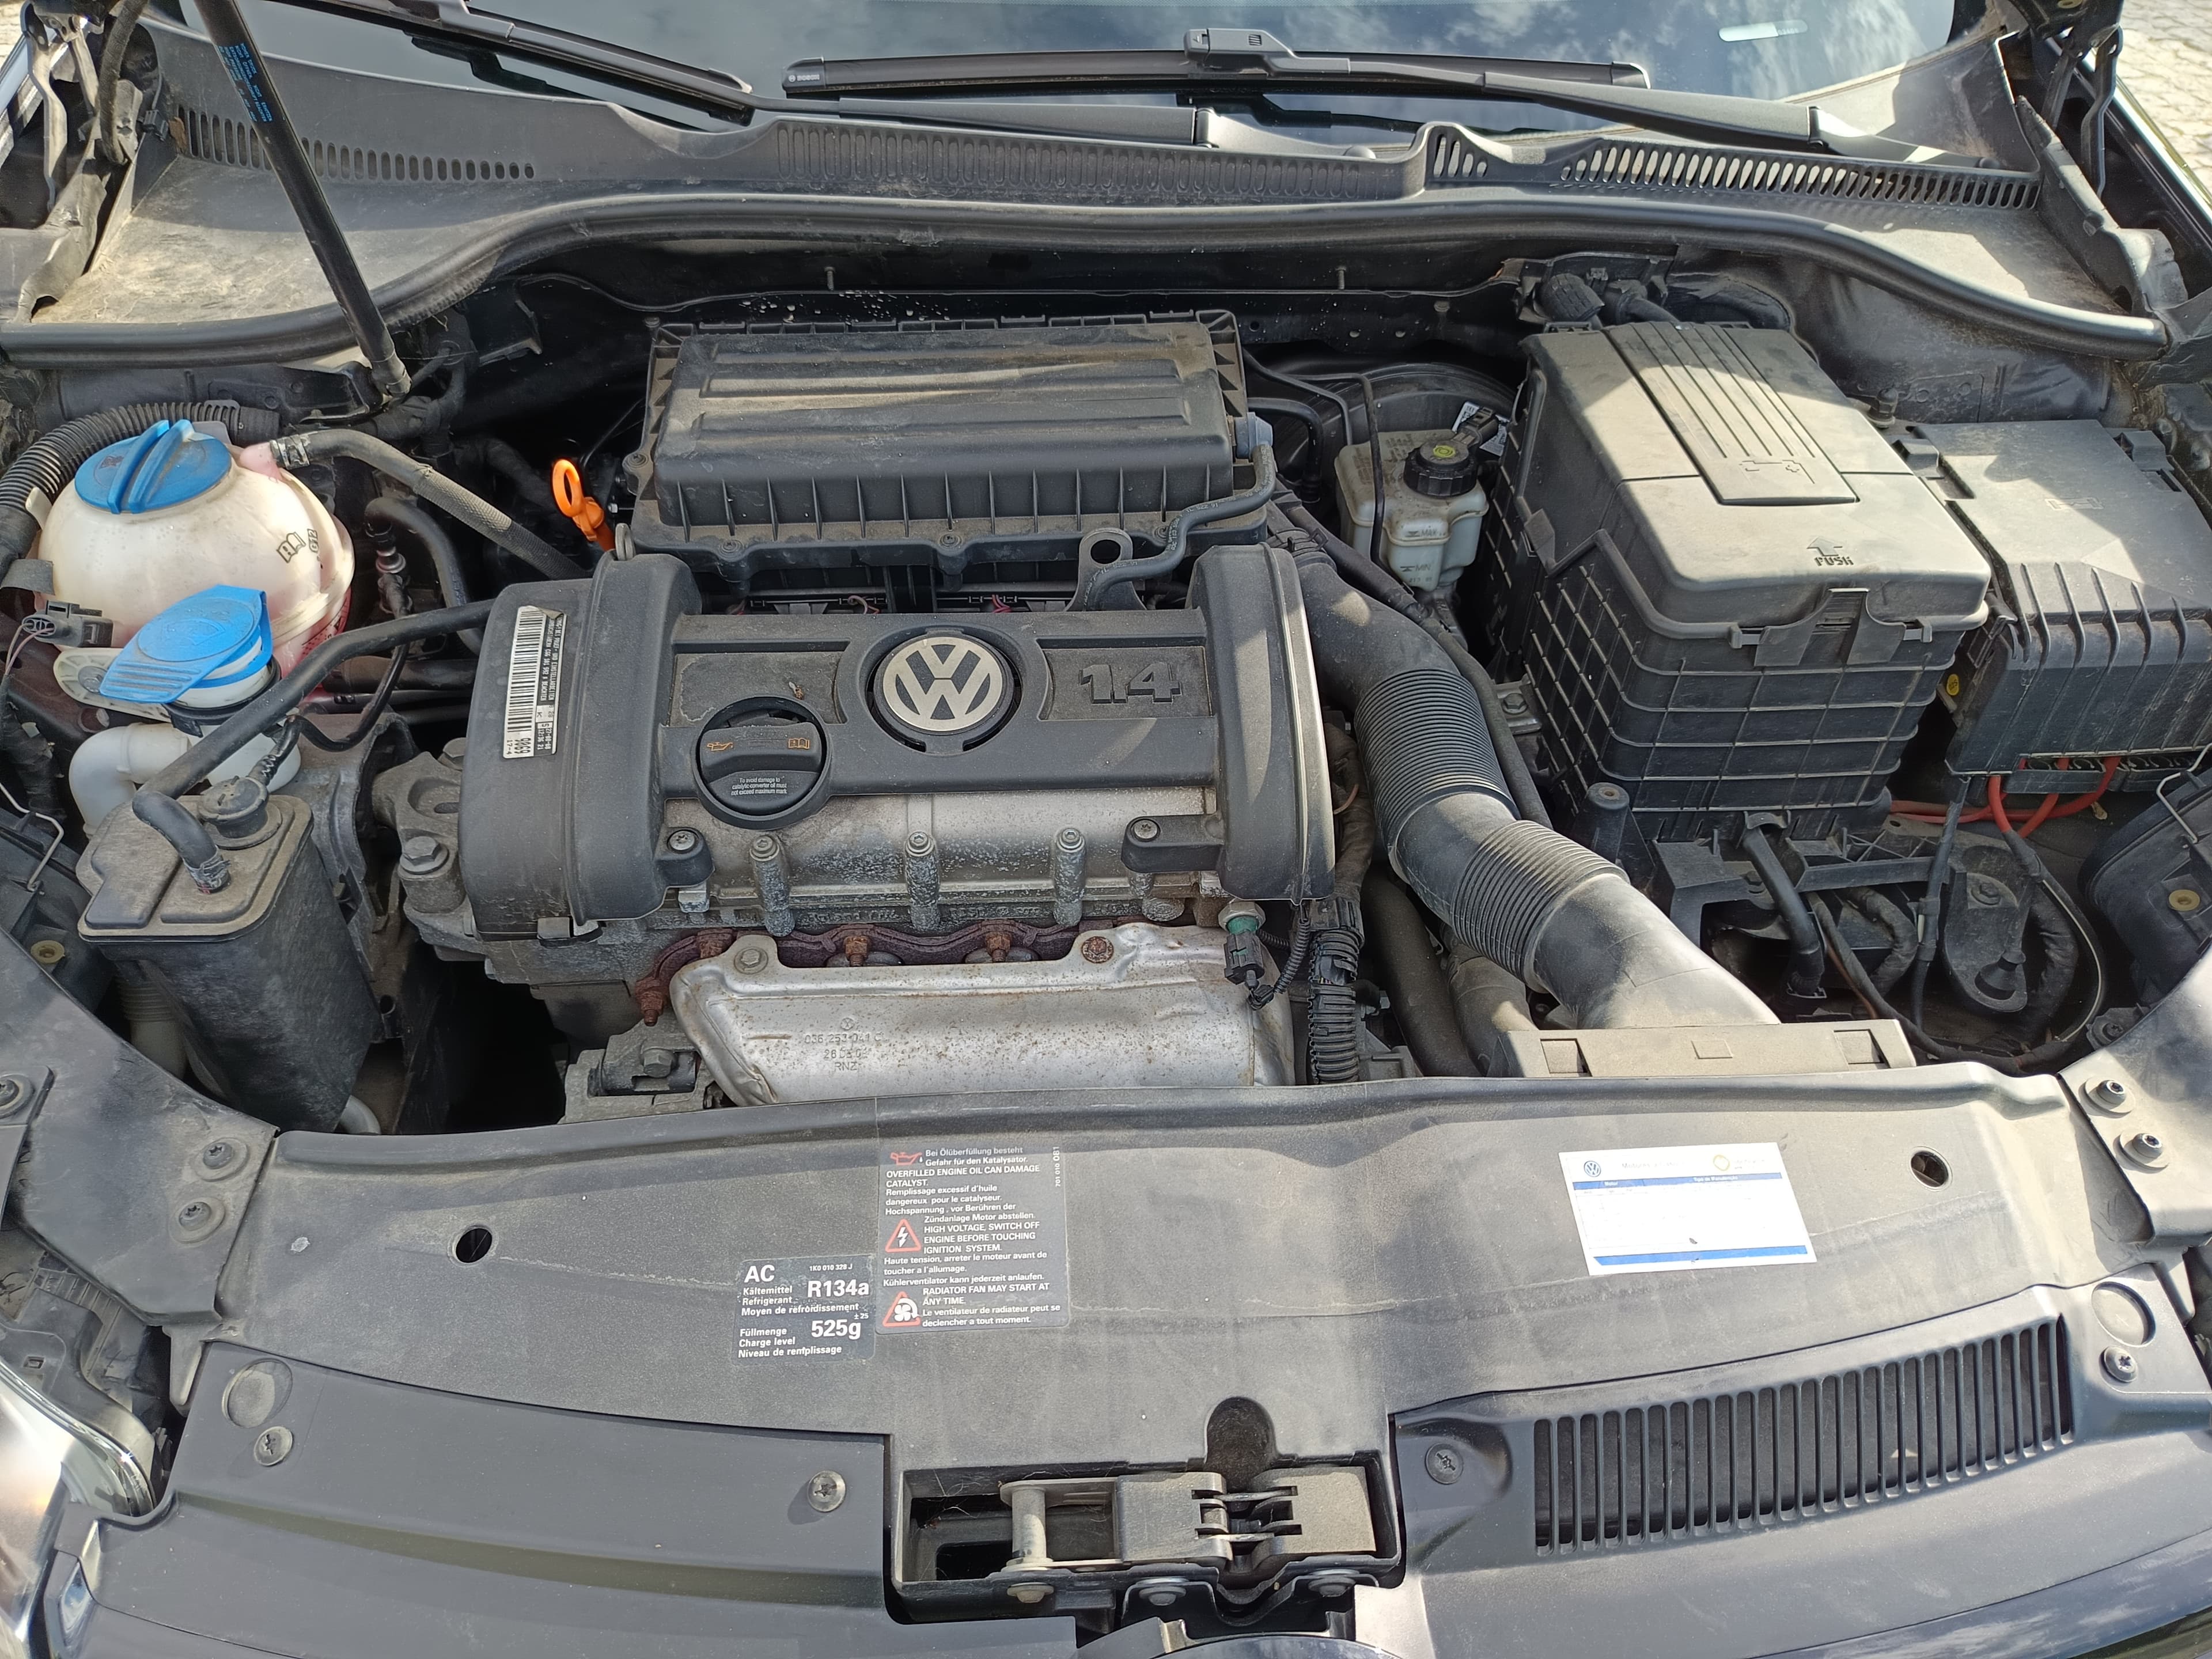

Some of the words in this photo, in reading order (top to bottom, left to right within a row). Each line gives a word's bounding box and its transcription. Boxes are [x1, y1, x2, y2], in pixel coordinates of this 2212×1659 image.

[307, 528, 319, 554] G12
[1814, 556, 1854, 566] PUSH
[883, 637, 1002, 731] VW
[1078, 662, 1182, 704] 1.4
[827, 1033, 847, 1043] 253
[824, 1048, 837, 1059] 26
[835, 1061, 858, 1071] RNZ
[940, 1147, 991, 1156] Ölüberfüllung
[925, 1158, 951, 1166] Gefahr
[983, 1156, 1028, 1165] Katalysator.
[886, 1169, 935, 1178] OVERFILLED
[937, 1168, 968, 1176] ENGINE
[984, 1166, 1002, 1174] CAN
[1004, 1165, 1040, 1173] DAMAGE
[886, 1179, 929, 1188] CATALYST.
[885, 1188, 935, 1196] Remplissage
[937, 1185, 969, 1194] excessif
[971, 1184, 997, 1192] d'huile
[885, 1198, 927, 1207] dangereux
[960, 1194, 1002, 1203] catalyseur.
[924, 1215, 970, 1224] Zündanlage
[998, 1212, 1036, 1220] abstellen.
[924, 1225, 945, 1233] HIGH
[947, 1224, 986, 1232] VOLTAGE,
[988, 1222, 1022, 1230] SWITCH
[1024, 1221, 1040, 1229] OFF
[924, 1236, 955, 1244] ENGINE
[957, 1234, 990, 1243] BEFORE
[991, 1232, 1036, 1241] TOUCHING
[923, 1245, 961, 1254] IGNITION
[965, 1244, 1002, 1253] SYSTEM.
[884, 1257, 908, 1265] Haute
[910, 1256, 942, 1264] tension,
[744, 1264, 775, 1283] AC
[884, 1267, 915, 1275] toucher
[923, 1266, 967, 1274] l'allumage.
[883, 1277, 948, 1286] Kühlerventilator
[949, 1276, 969, 1284] kann
[971, 1274, 1006, 1284] jederzeit
[1007, 1272, 1044, 1281] anlaufen.
[743, 1286, 793, 1296] Kältemittel
[807, 1279, 869, 1298] R134a
[923, 1286, 967, 1295] RADIATOR
[968, 1285, 986, 1293] FAN
[987, 1285, 1007, 1293] MAY
[1009, 1283, 1037, 1291] START
[1038, 1282, 1050, 1290] AT
[742, 1296, 792, 1306] Refrigerant
[922, 1298, 941, 1306] ANY
[943, 1297, 966, 1305] TIME.
[741, 1307, 772, 1317] Moyen
[775, 1306, 786, 1315] de
[789, 1303, 859, 1313] refroidissement
[934, 1308, 978, 1316] ventilateur
[991, 1305, 1029, 1313] radiateur
[1030, 1305, 1049, 1313] peut
[922, 1319, 968, 1327] declencher
[740, 1328, 787, 1337] Füllmenge
[811, 1319, 861, 1340] 525g
[738, 1339, 771, 1348] Charge
[774, 1336, 796, 1345] level
[738, 1350, 770, 1358] Niveau
[772, 1348, 785, 1356] de
[787, 1346, 842, 1357] remplissage
